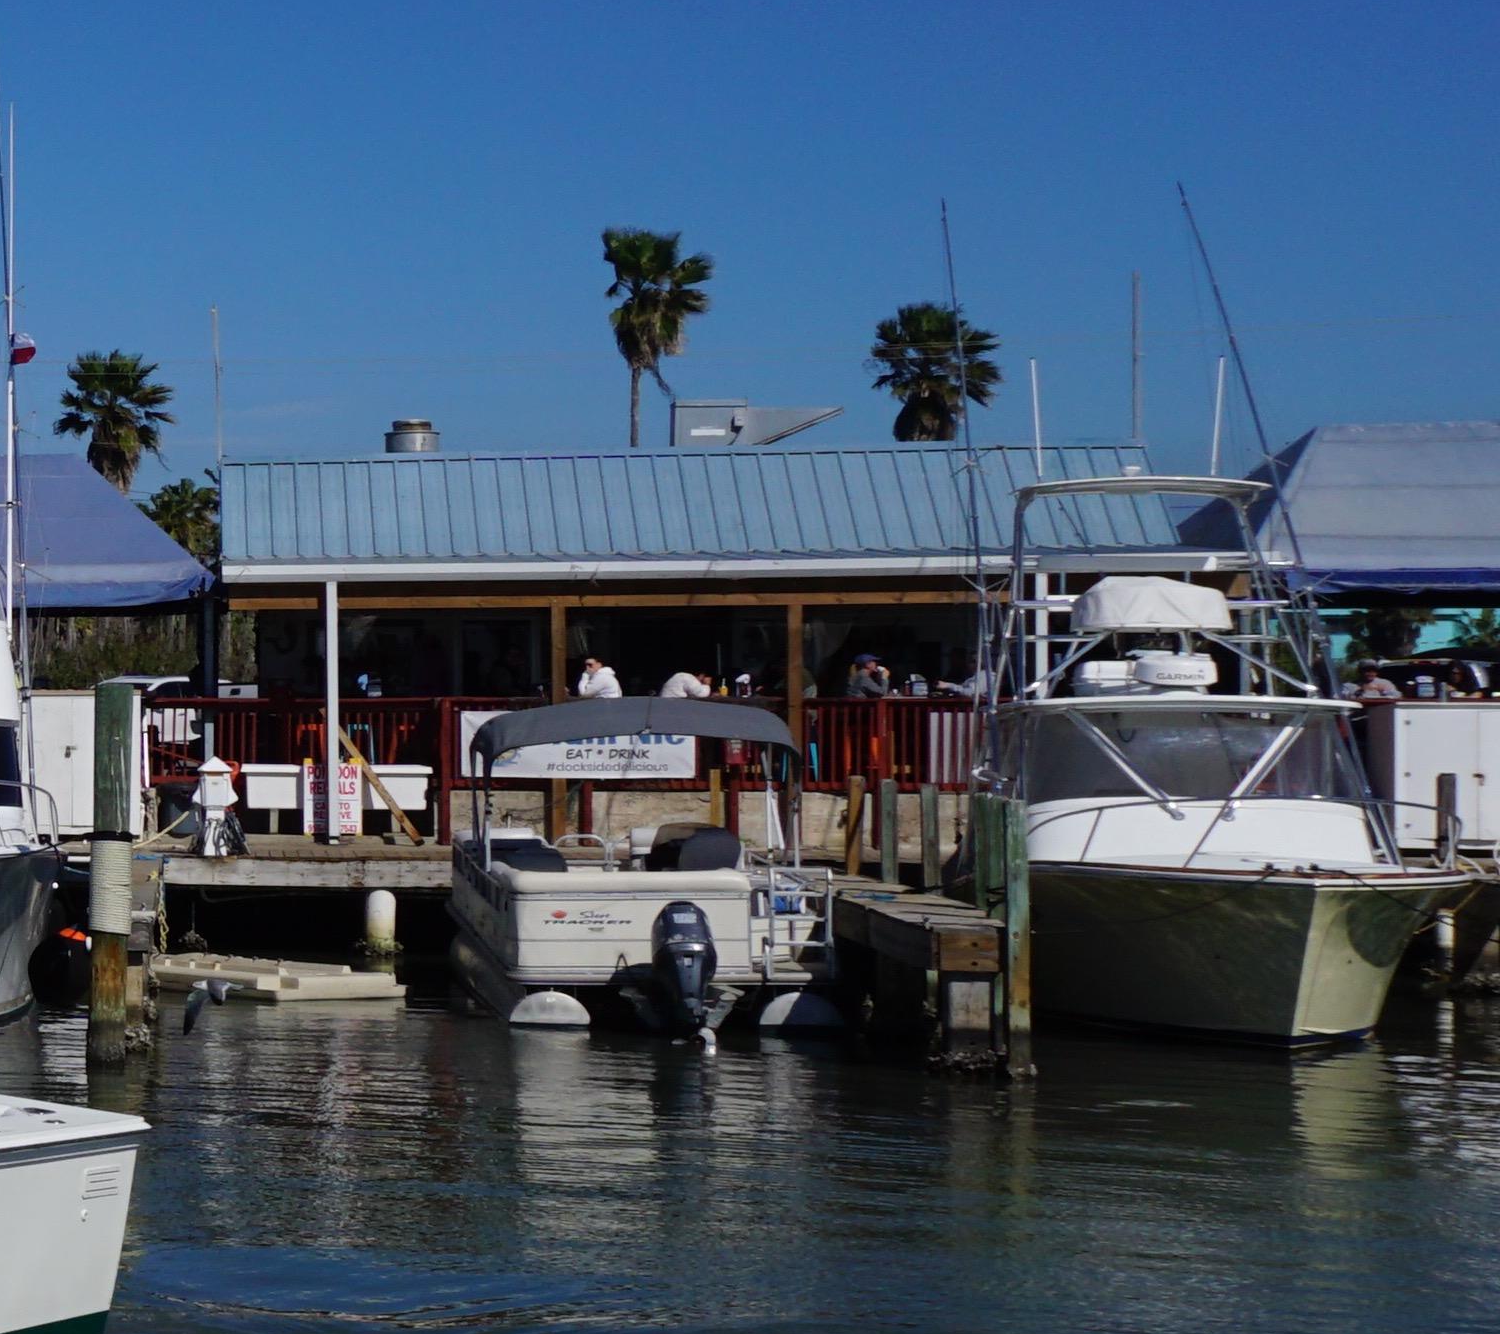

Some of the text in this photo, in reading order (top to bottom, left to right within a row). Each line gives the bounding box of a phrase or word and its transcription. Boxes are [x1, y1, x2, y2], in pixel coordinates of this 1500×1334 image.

[1155, 673, 1205, 681] GARMIN
[566, 749, 650, 759] EAT DRINK
[307, 765, 358, 779] POON
